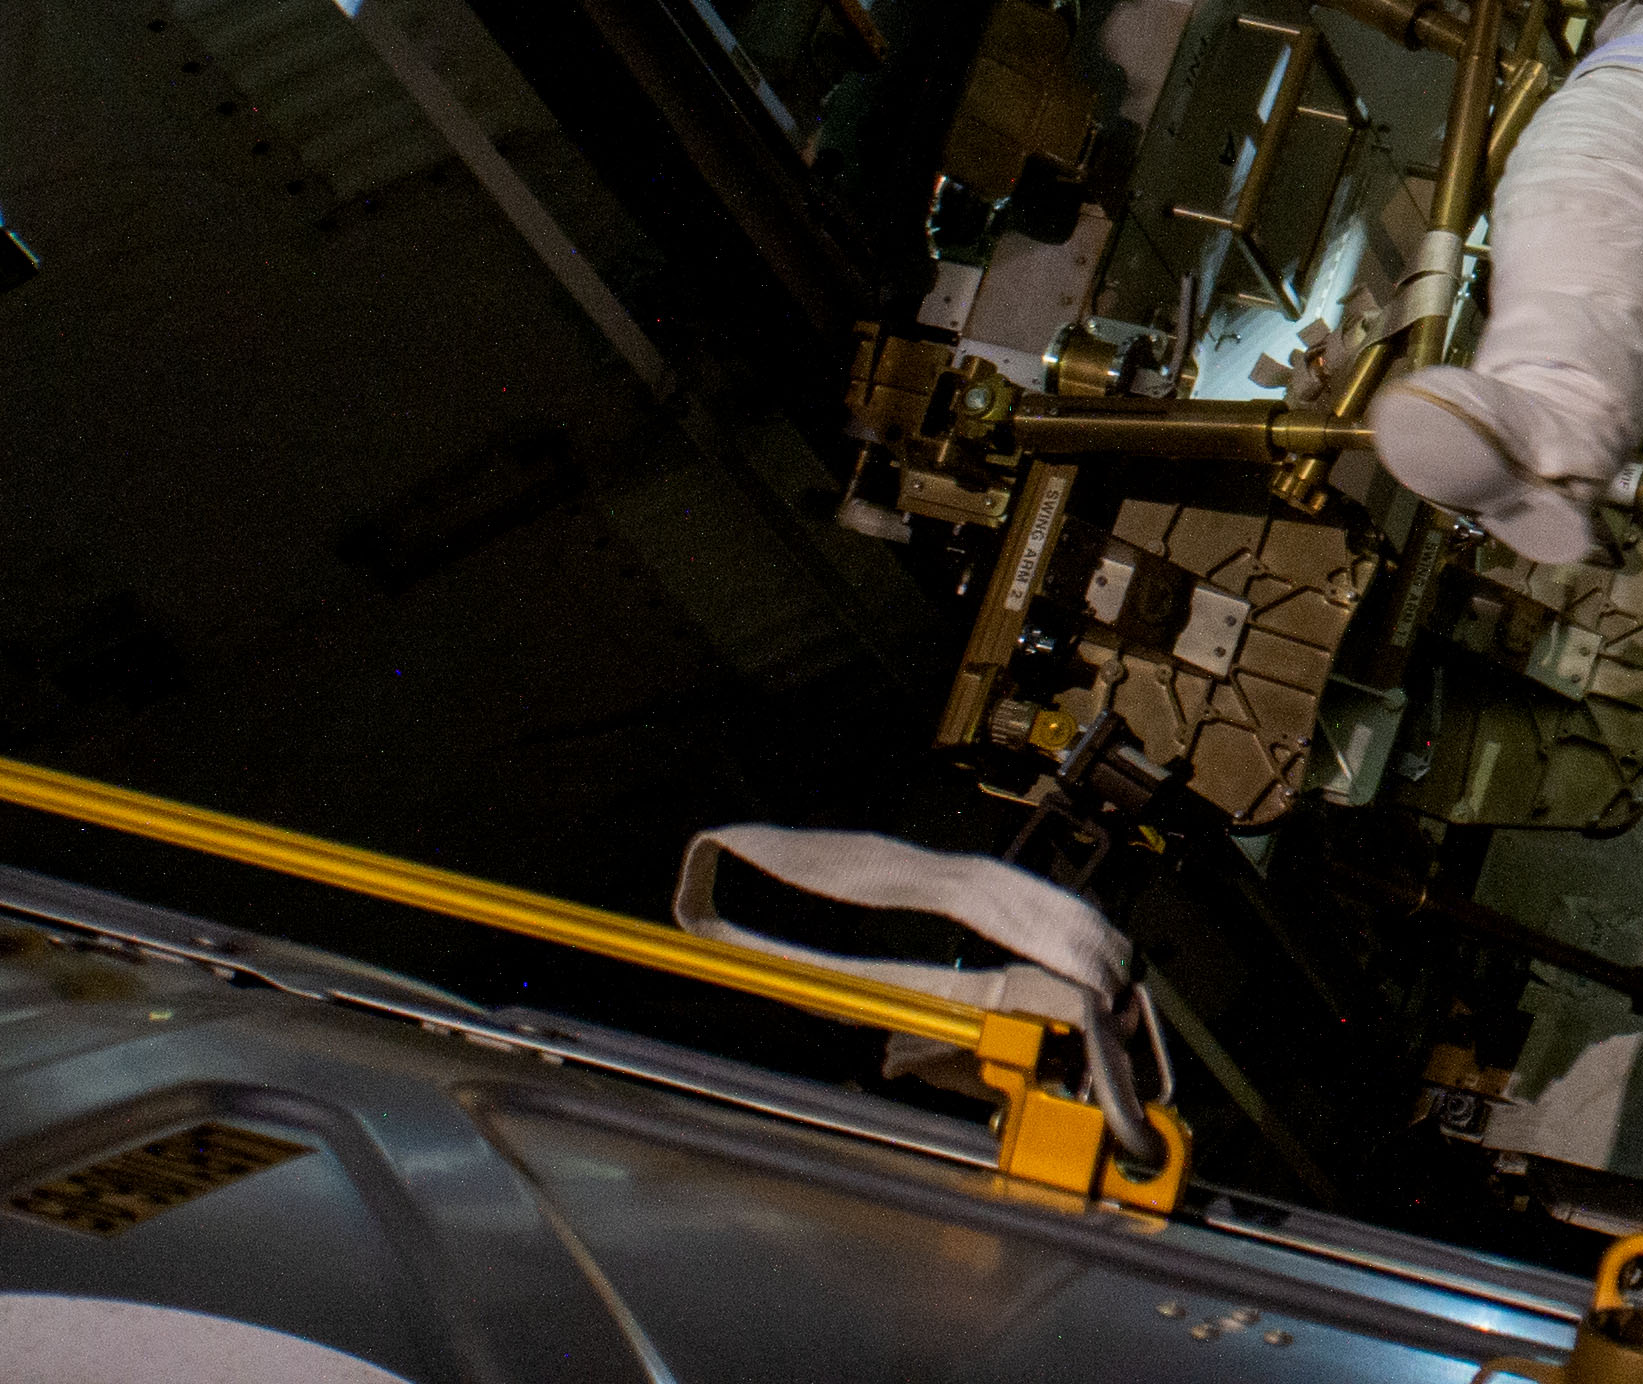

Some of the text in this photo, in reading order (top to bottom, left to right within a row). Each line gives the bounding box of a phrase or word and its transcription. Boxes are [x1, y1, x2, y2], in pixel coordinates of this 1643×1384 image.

[1011, 489, 1059, 599] SWING ARM 2
